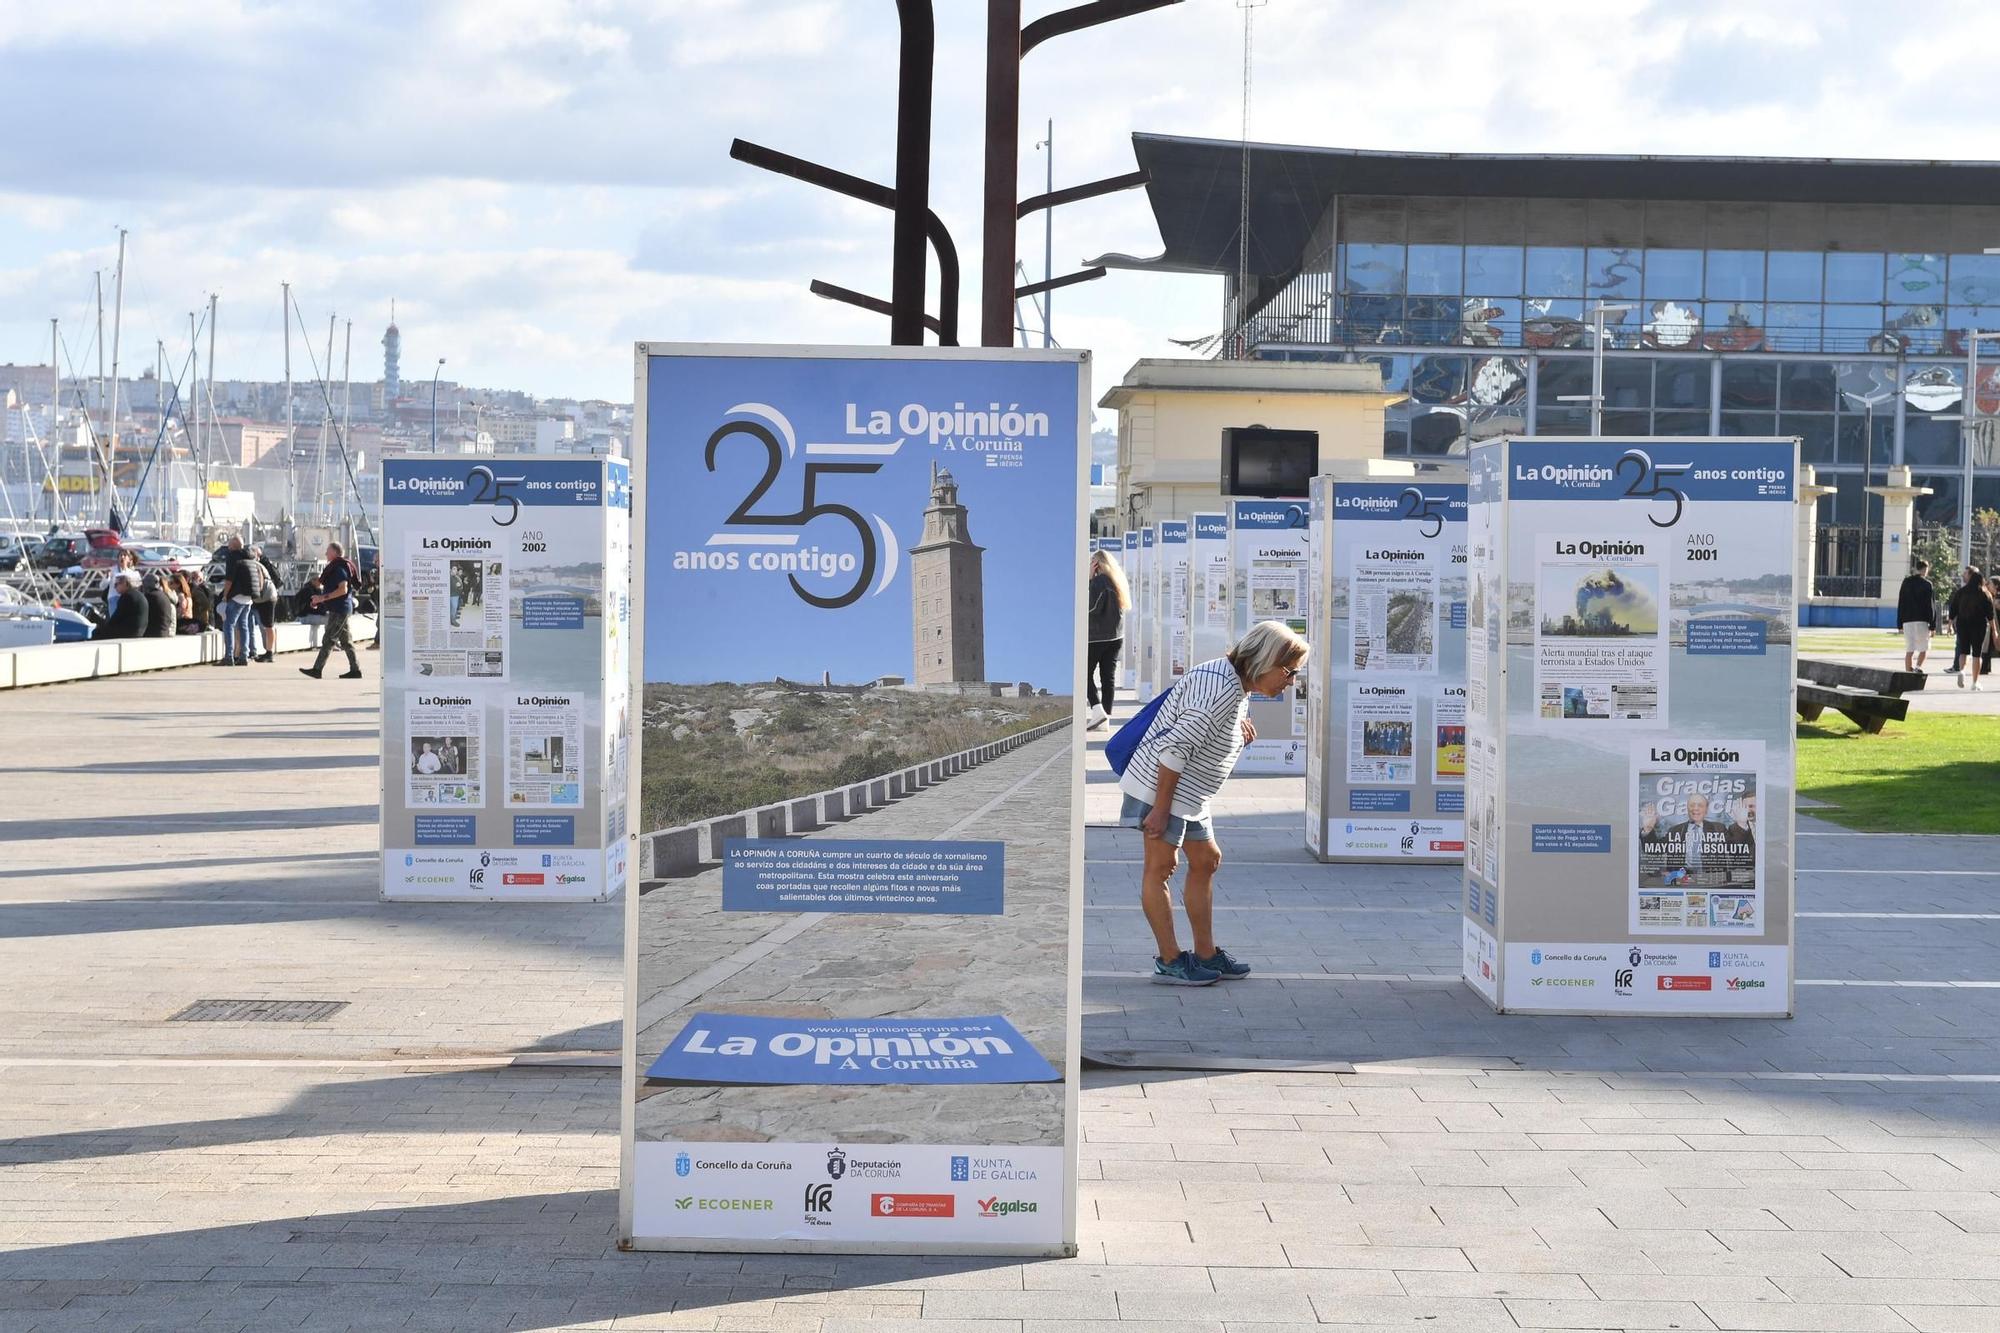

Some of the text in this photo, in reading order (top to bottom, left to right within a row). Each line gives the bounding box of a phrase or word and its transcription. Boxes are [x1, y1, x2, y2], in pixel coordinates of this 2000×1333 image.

[846, 402, 1048, 444] La Opinión
[944, 436, 1023, 452] A Coruña
[1516, 464, 1613, 484] La Opinión
[1694, 468, 1785, 483] anos contigo
[389, 477, 464, 493] La Opinión
[526, 480, 596, 492] anos contigo
[1571, 480, 1600, 488] Coruña
[1615, 452, 1687, 527] 25
[466, 468, 521, 526] 25
[1336, 497, 1398, 510] La Opinión
[704, 420, 884, 609] 25
[1239, 512, 1284, 522] La Opinión
[1400, 488, 1445, 538] 25
[1208, 524, 1226, 533] Opin
[522, 531, 543, 540] ANO
[1687, 534, 1714, 546] ANO
[422, 537, 491, 552] La Opinión
[522, 543, 546, 552] 2002
[1556, 540, 1644, 558] La Opinión
[1270, 549, 1301, 558] Opinión
[1366, 550, 1424, 562] La Opinión
[1452, 555, 1467, 563] 200
[1687, 549, 1718, 561] 2001
[673, 545, 855, 577] anos contigo
[1540, 648, 1653, 660] Alerta mundial tras el ataque
[1540, 658, 1576, 666] terrorista
[1584, 658, 1615, 666] Estados
[1617, 658, 1645, 666] Unidos
[1372, 687, 1405, 697] Opinión
[1444, 688, 1455, 696] La
[418, 696, 471, 707] La Opinión
[517, 696, 570, 707] La Opinión
[1651, 748, 1739, 765] La Opinión
[1656, 776, 1746, 795] Gracias
[1657, 795, 1737, 816] Gaci
[1668, 832, 1726, 842] LA CUARTA
[730, 850, 740, 858] LA
[743, 849, 776, 858] OPINIÓN
[780, 850, 785, 858] A
[786, 849, 820, 858] CORUÑA
[822, 851, 852, 860] cumpre
[1697, 844, 1749, 854] ABSOLUTA
[792, 861, 827, 869] cidadáns
[852, 862, 888, 870] intereses
[890, 862, 900, 870] da
[965, 862, 983, 871] área
[759, 872, 815, 881] metropolitana.
[818, 872, 834, 880] Esta
[776, 883, 811, 891] portadas
[813, 884, 828, 892] que
[863, 884, 888, 892] algúns
[942, 884, 961, 892] máis
[845, 894, 873, 902] últimos
[682, 1030, 1014, 1064] La Opinión
[839, 1056, 978, 1070] A Coruña
[696, 1160, 792, 1170] Concello da Coruña
[850, 1159, 901, 1170] Deputación
[973, 1159, 1012, 1168] XUNTA
[850, 1168, 900, 1178] DA CORUÑA
[972, 1171, 1037, 1180] DE GALICIA
[699, 1199, 773, 1210] ECOENER
[978, 1197, 1037, 1215] Vegalsa
